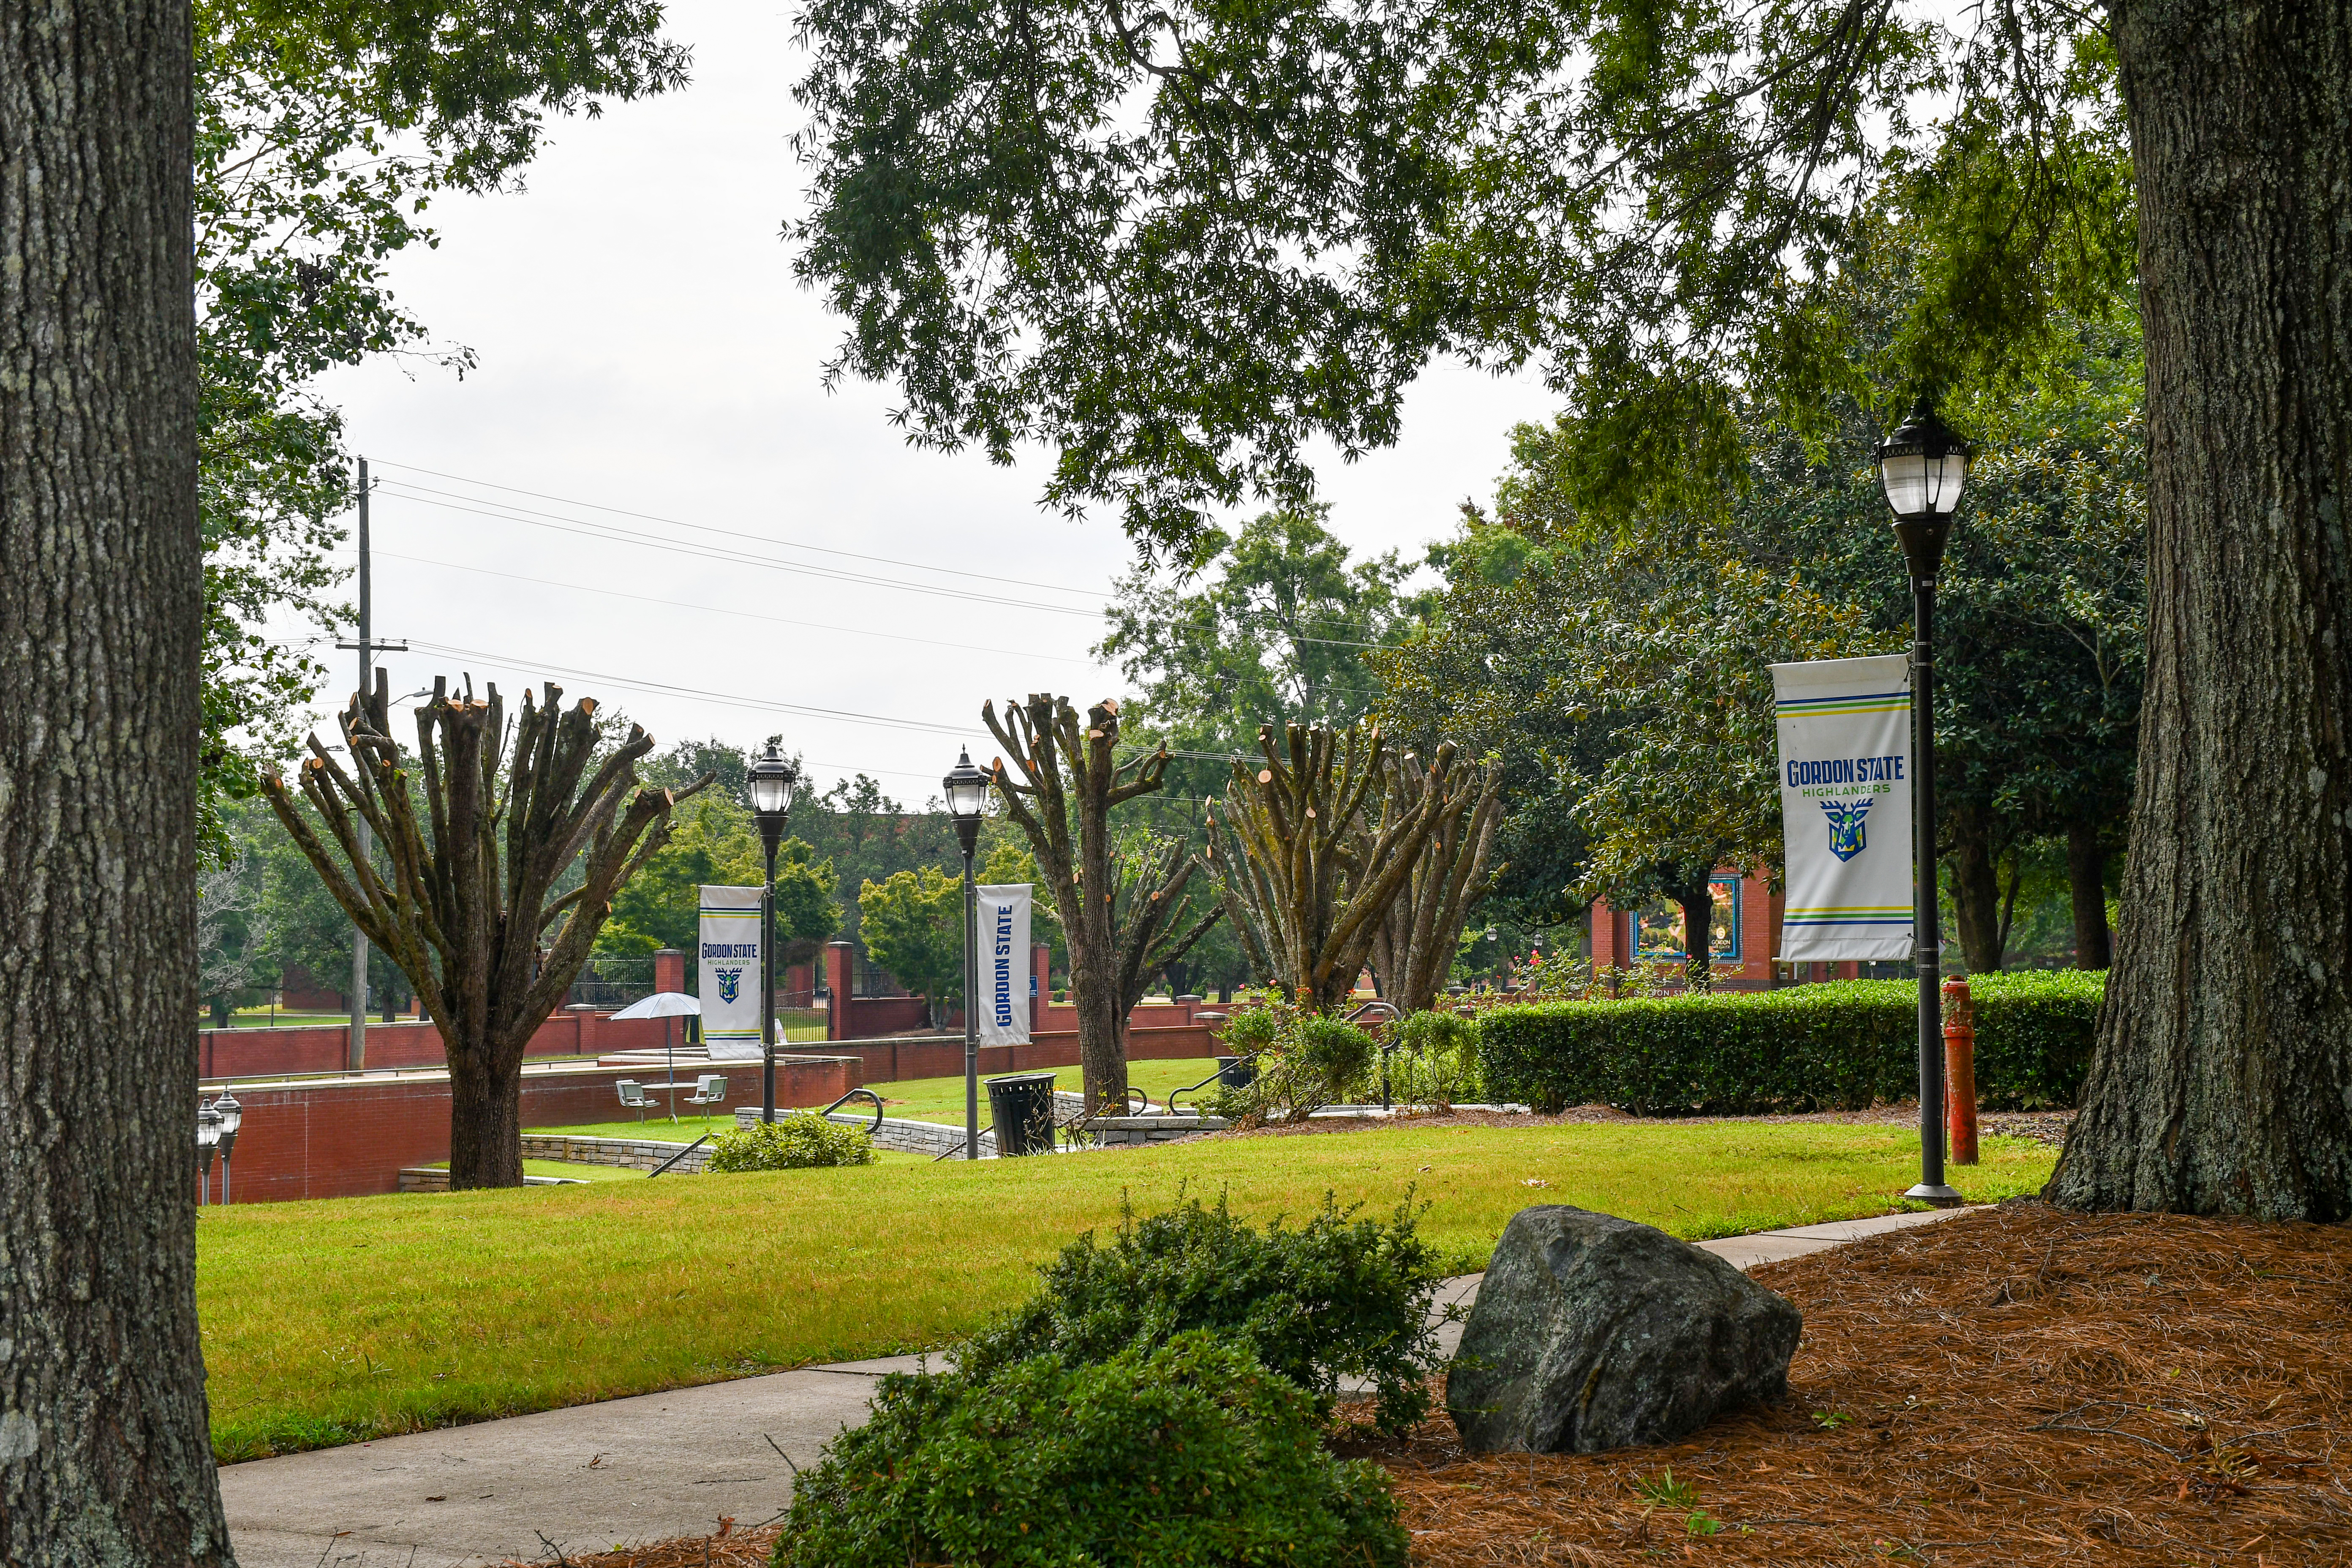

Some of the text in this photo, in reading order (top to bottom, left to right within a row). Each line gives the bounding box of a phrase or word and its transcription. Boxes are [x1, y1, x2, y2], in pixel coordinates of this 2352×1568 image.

[1787, 756, 1904, 788] GORDON STATE
[1802, 784, 1891, 798] HIGHLANDERS
[702, 942, 757, 959] GORDON STATE
[995, 904, 1013, 1027] GORDON STATE
